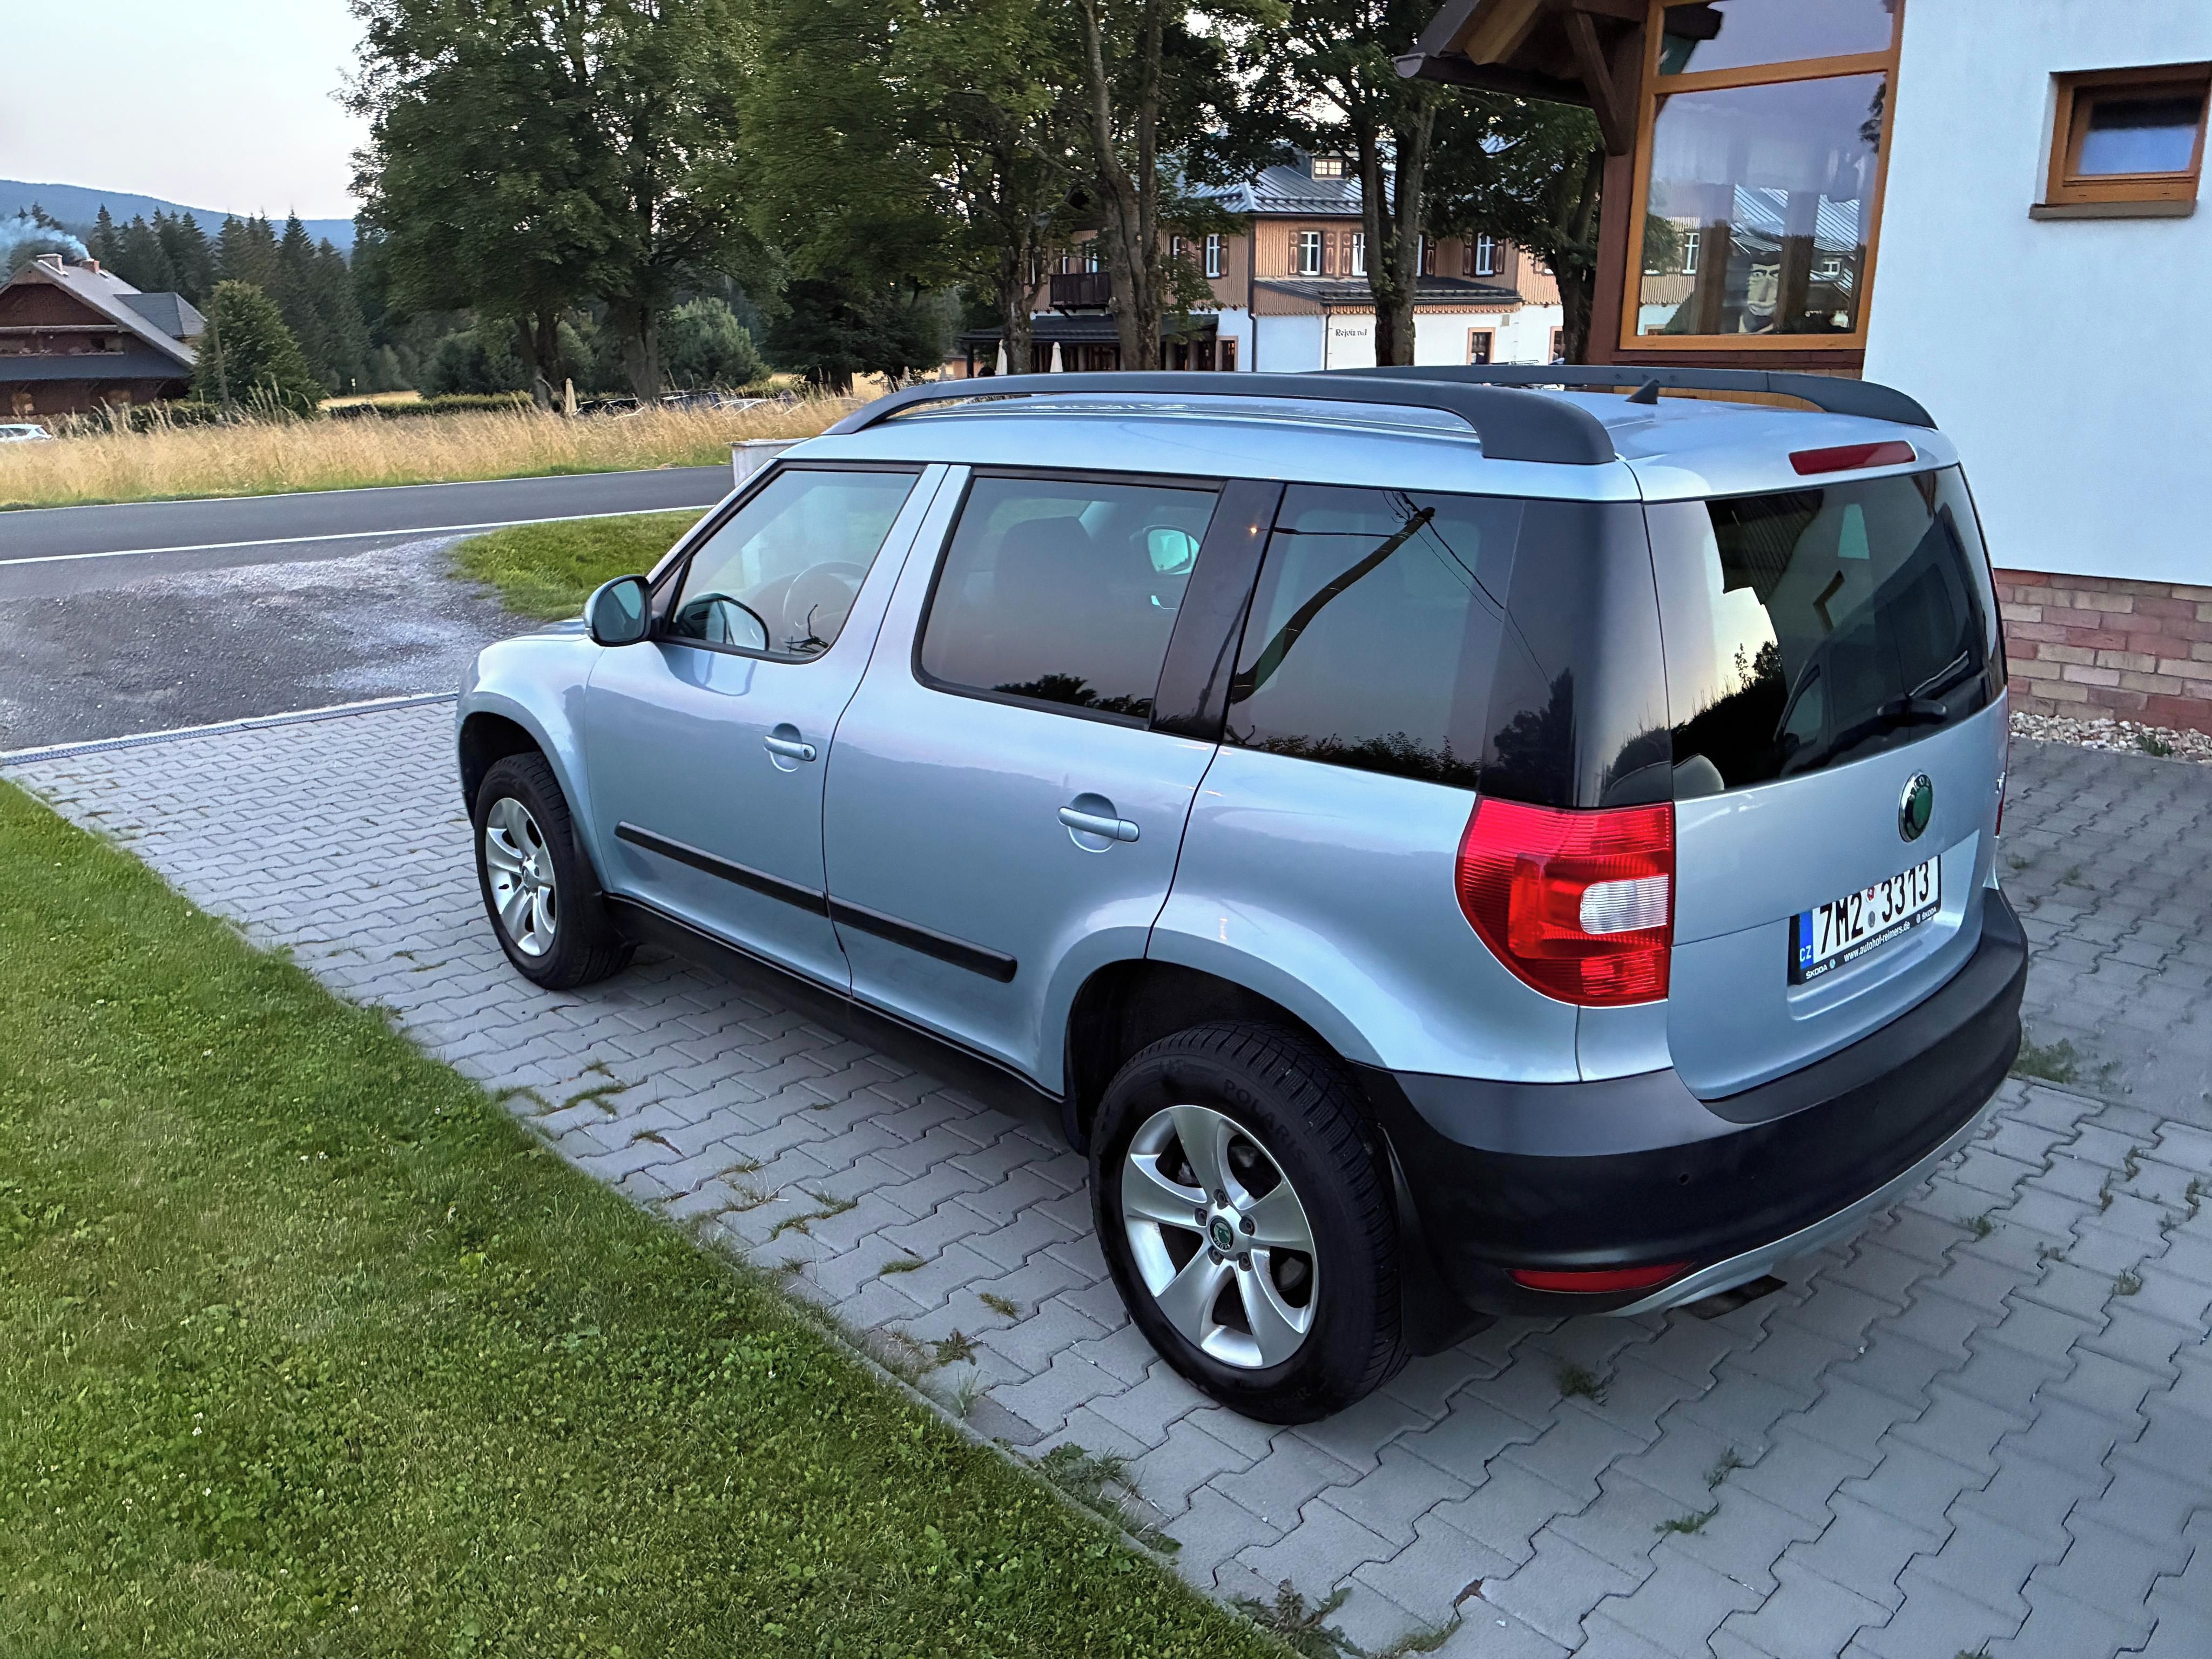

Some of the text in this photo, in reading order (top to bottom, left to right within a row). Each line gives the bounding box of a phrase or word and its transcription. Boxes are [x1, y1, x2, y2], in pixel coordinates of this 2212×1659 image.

[1819, 860, 1929, 955] 7M2 3313
[1799, 945, 1812, 962] CZ
[1843, 920, 1911, 962] www.autohof-reimers.de
